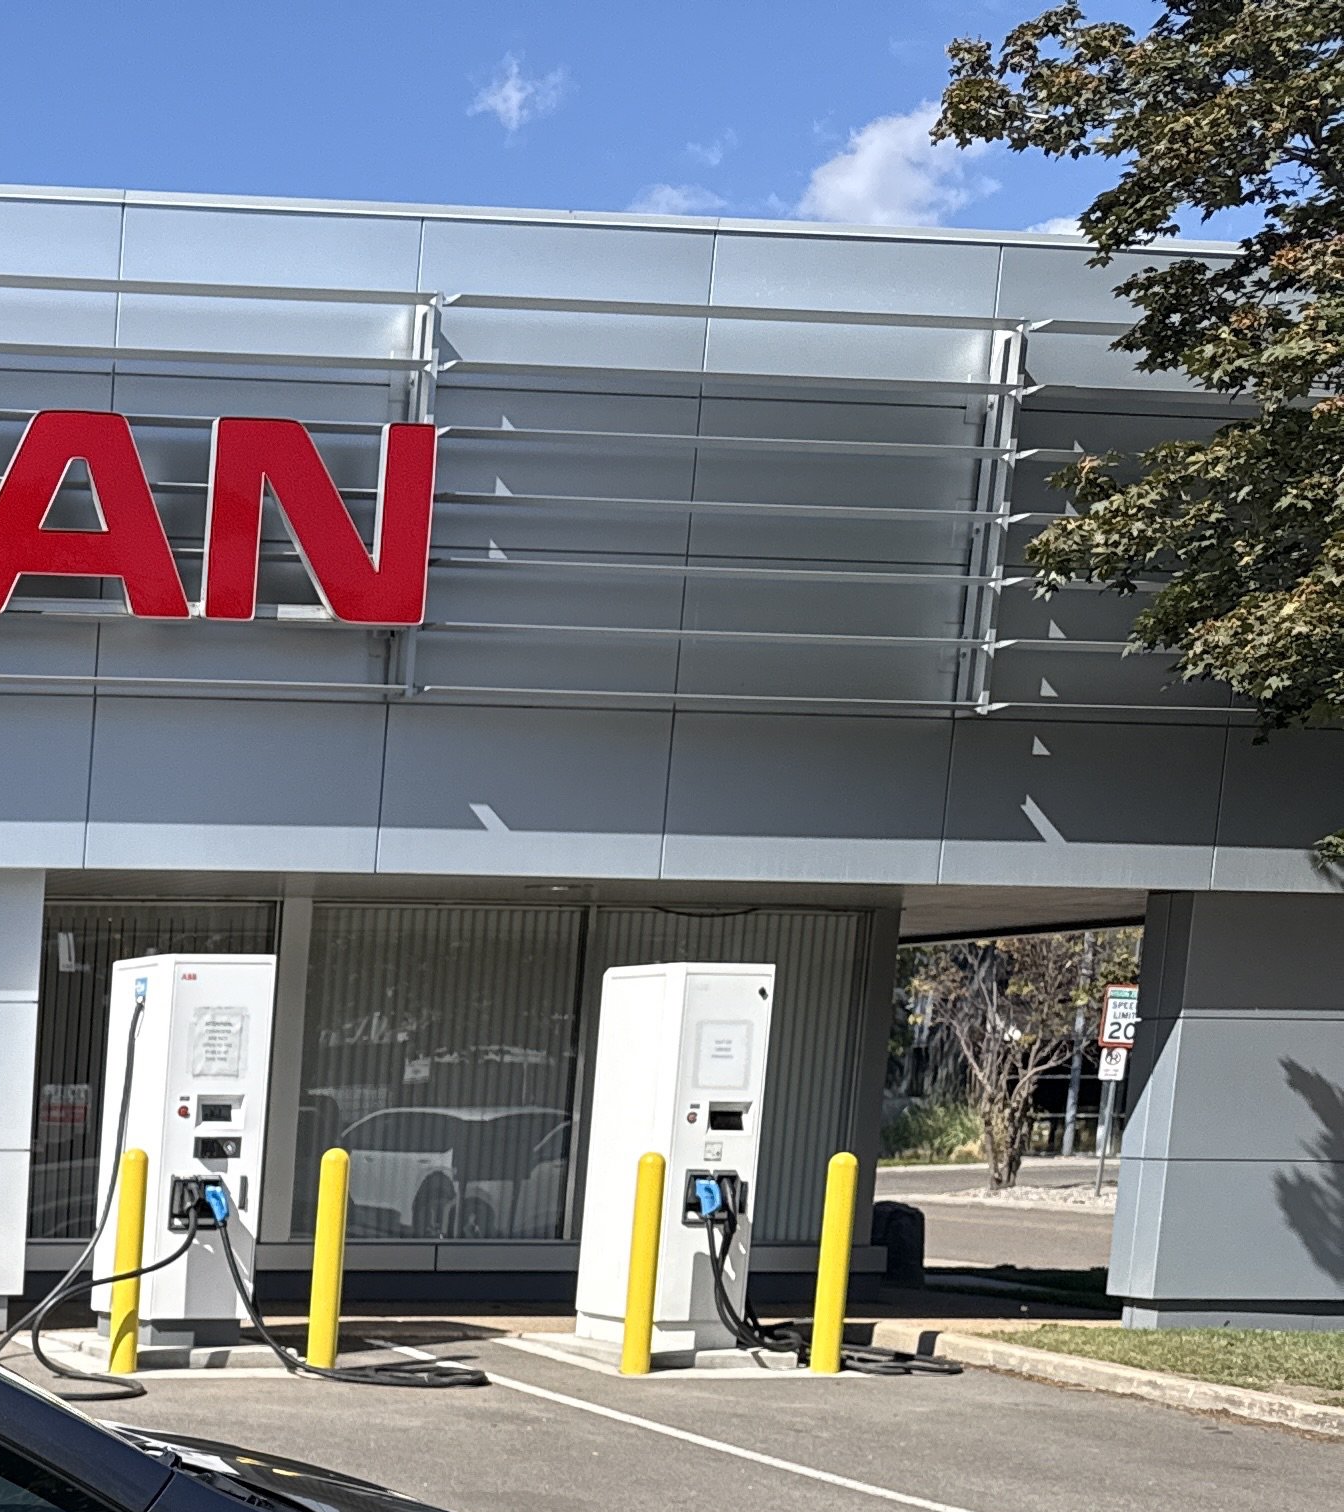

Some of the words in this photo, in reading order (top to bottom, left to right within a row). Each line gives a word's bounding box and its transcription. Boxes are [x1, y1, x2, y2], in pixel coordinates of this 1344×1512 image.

[181, 973, 197, 981] ABB
[1112, 1001, 1137, 1010] SPEE
[1108, 1021, 1136, 1040] 20
